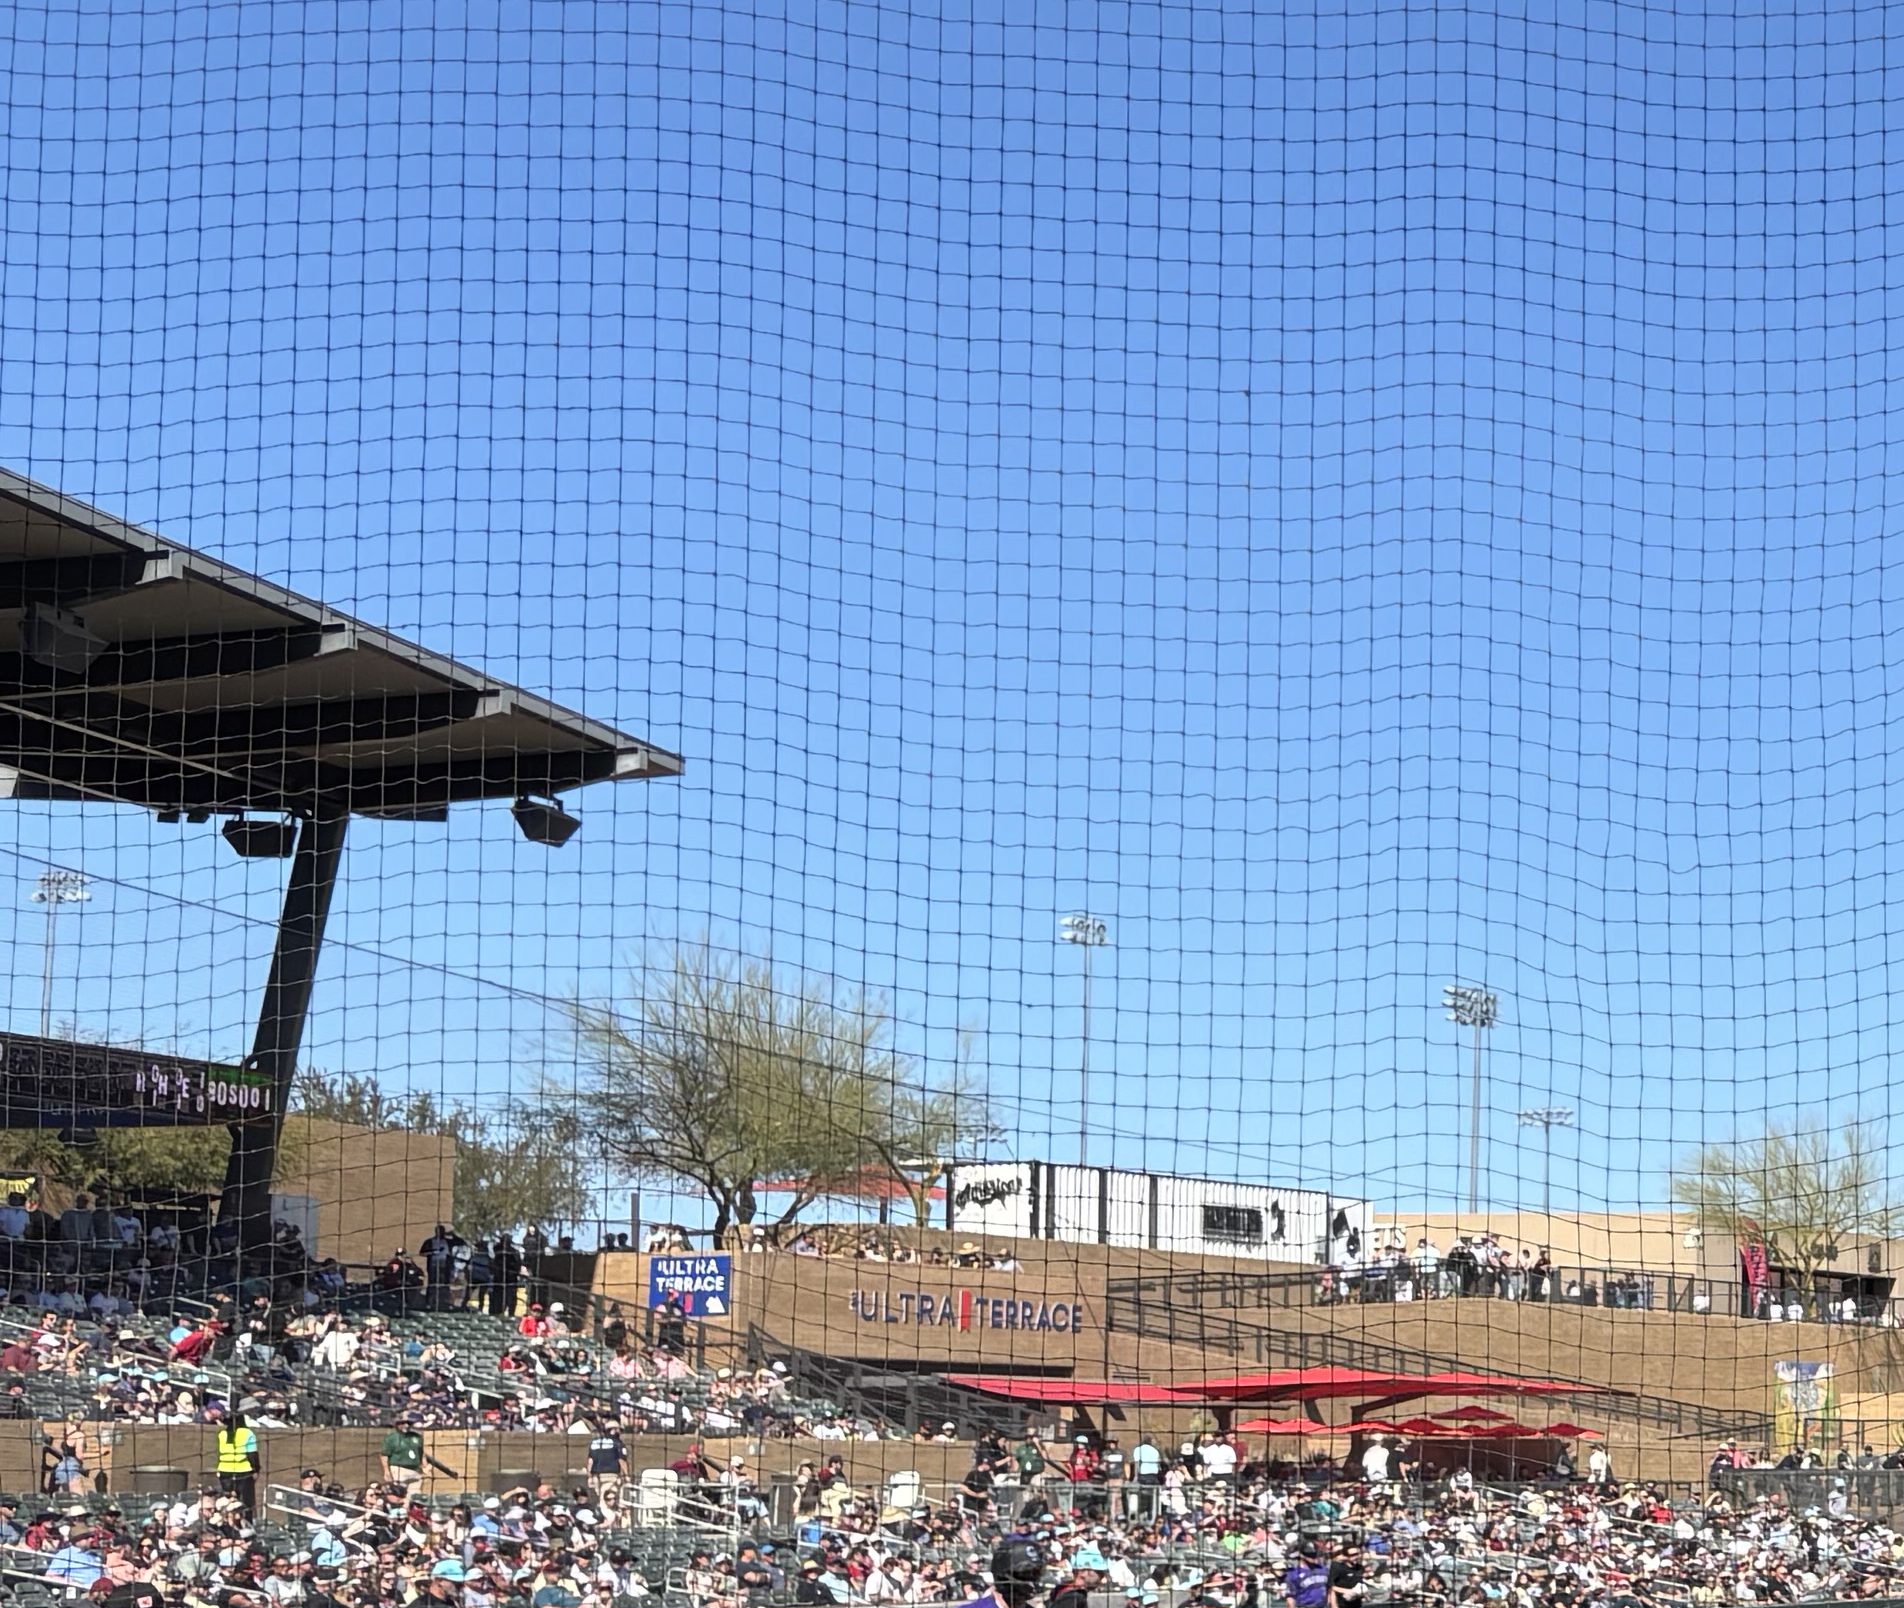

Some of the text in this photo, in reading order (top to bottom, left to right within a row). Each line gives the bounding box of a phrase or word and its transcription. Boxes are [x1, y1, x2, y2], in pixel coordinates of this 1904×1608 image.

[662, 1259, 718, 1275] ULTRA
[656, 1275, 724, 1292] TERRACE
[859, 1290, 956, 1326] ULTRA
[975, 1296, 1083, 1333] TERRACE
